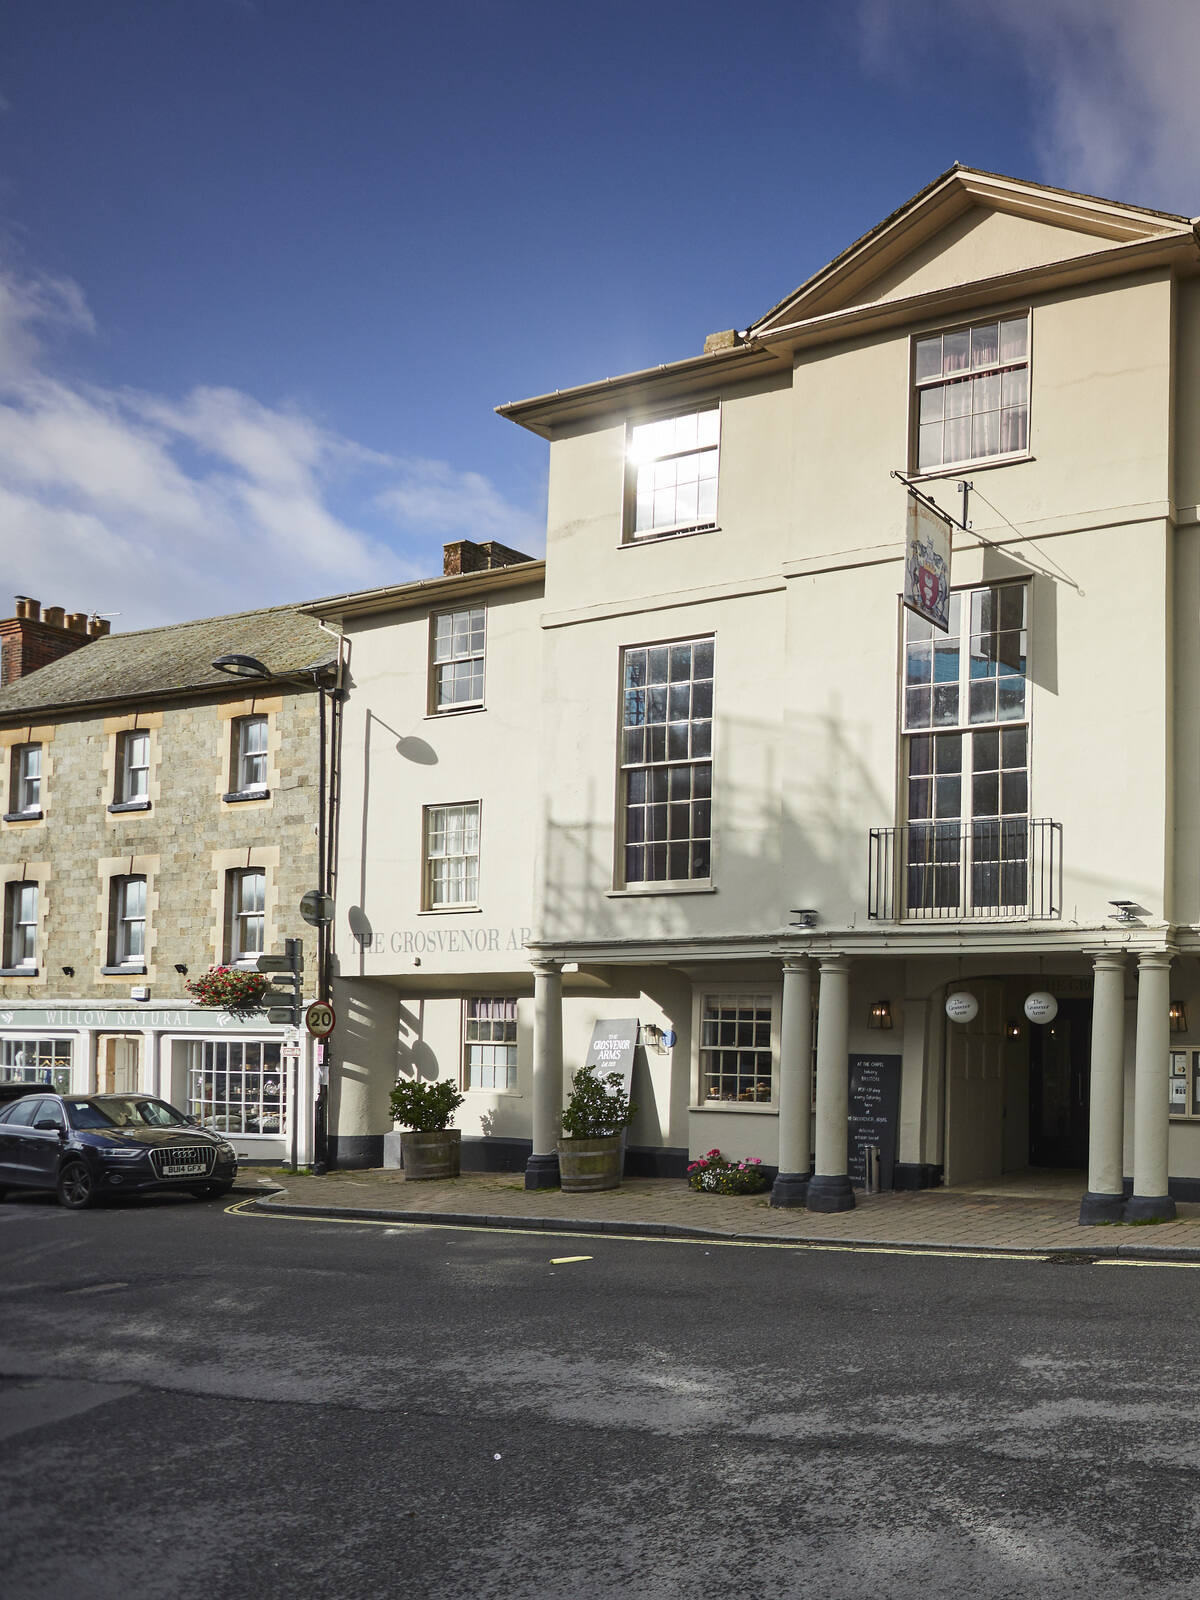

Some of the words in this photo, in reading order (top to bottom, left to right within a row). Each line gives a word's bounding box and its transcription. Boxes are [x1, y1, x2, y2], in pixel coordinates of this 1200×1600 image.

[349, 932, 385, 955] THE
[391, 928, 500, 953] GROSVENOR
[45, 1010, 107, 1025] WILLOW
[117, 1010, 192, 1025] NATURAL
[310, 1011, 332, 1027] 20
[594, 1039, 631, 1049] GROSVENOR
[598, 1050, 621, 1060] ARMS
[169, 1166, 186, 1174] BU14
[187, 1165, 202, 1173] GFX
